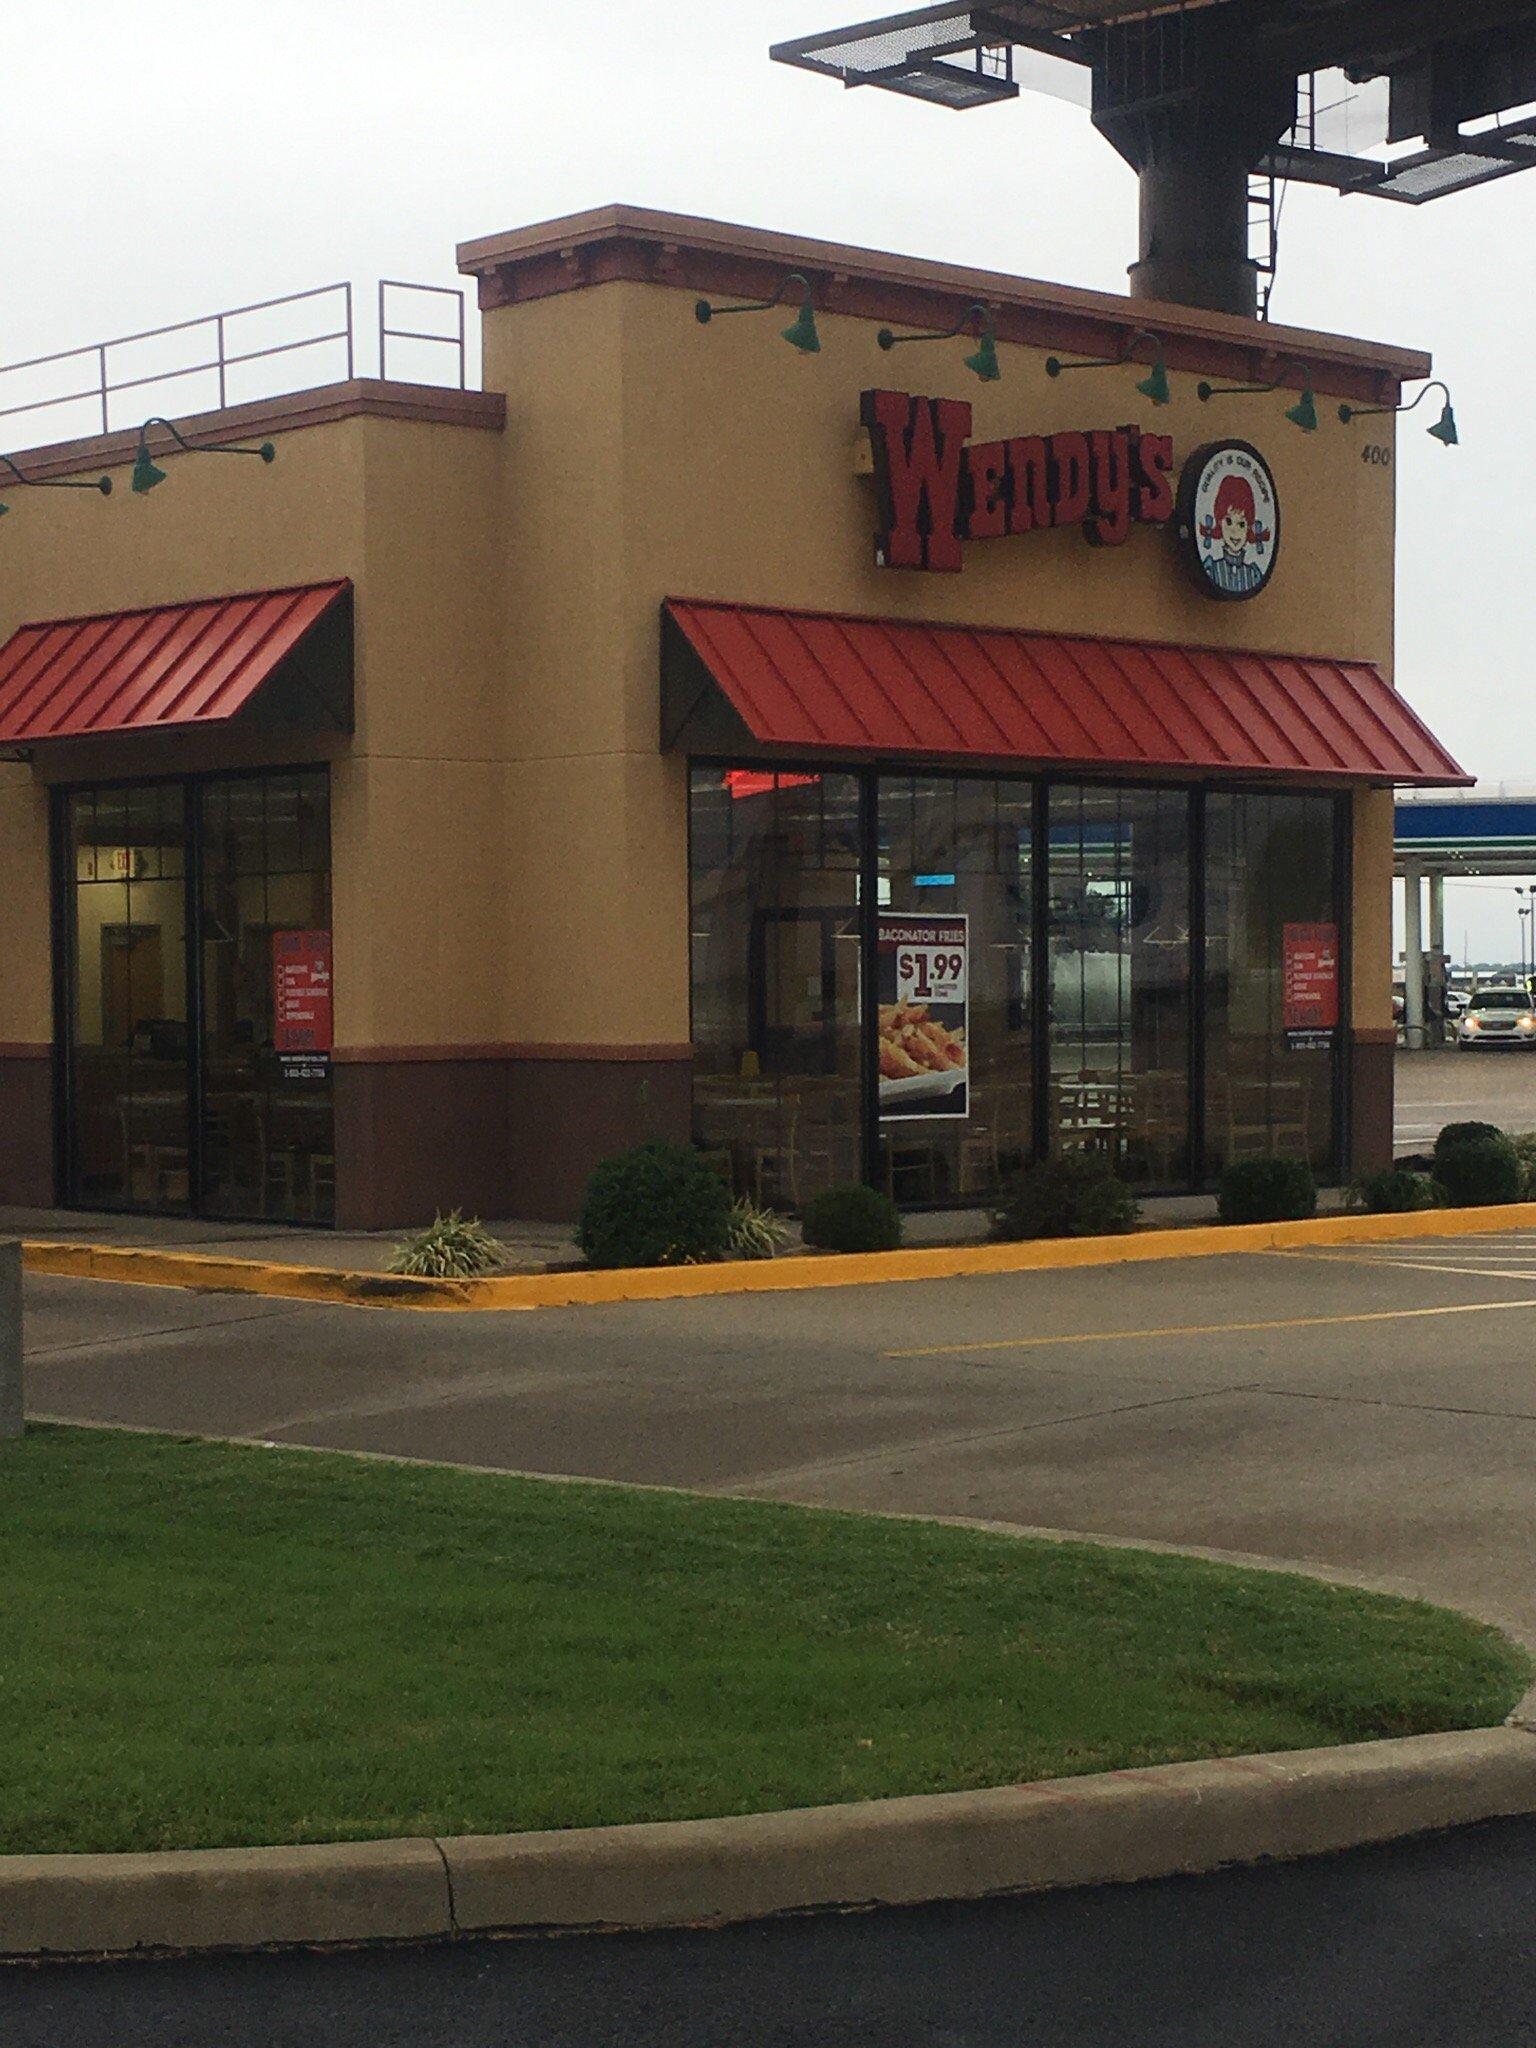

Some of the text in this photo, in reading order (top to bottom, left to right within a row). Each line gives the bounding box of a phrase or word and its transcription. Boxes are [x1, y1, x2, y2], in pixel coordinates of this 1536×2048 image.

[1361, 444, 1390, 466] 400
[878, 928, 964, 942] BACONATOR FRIES
[899, 953, 963, 997] $1.99
